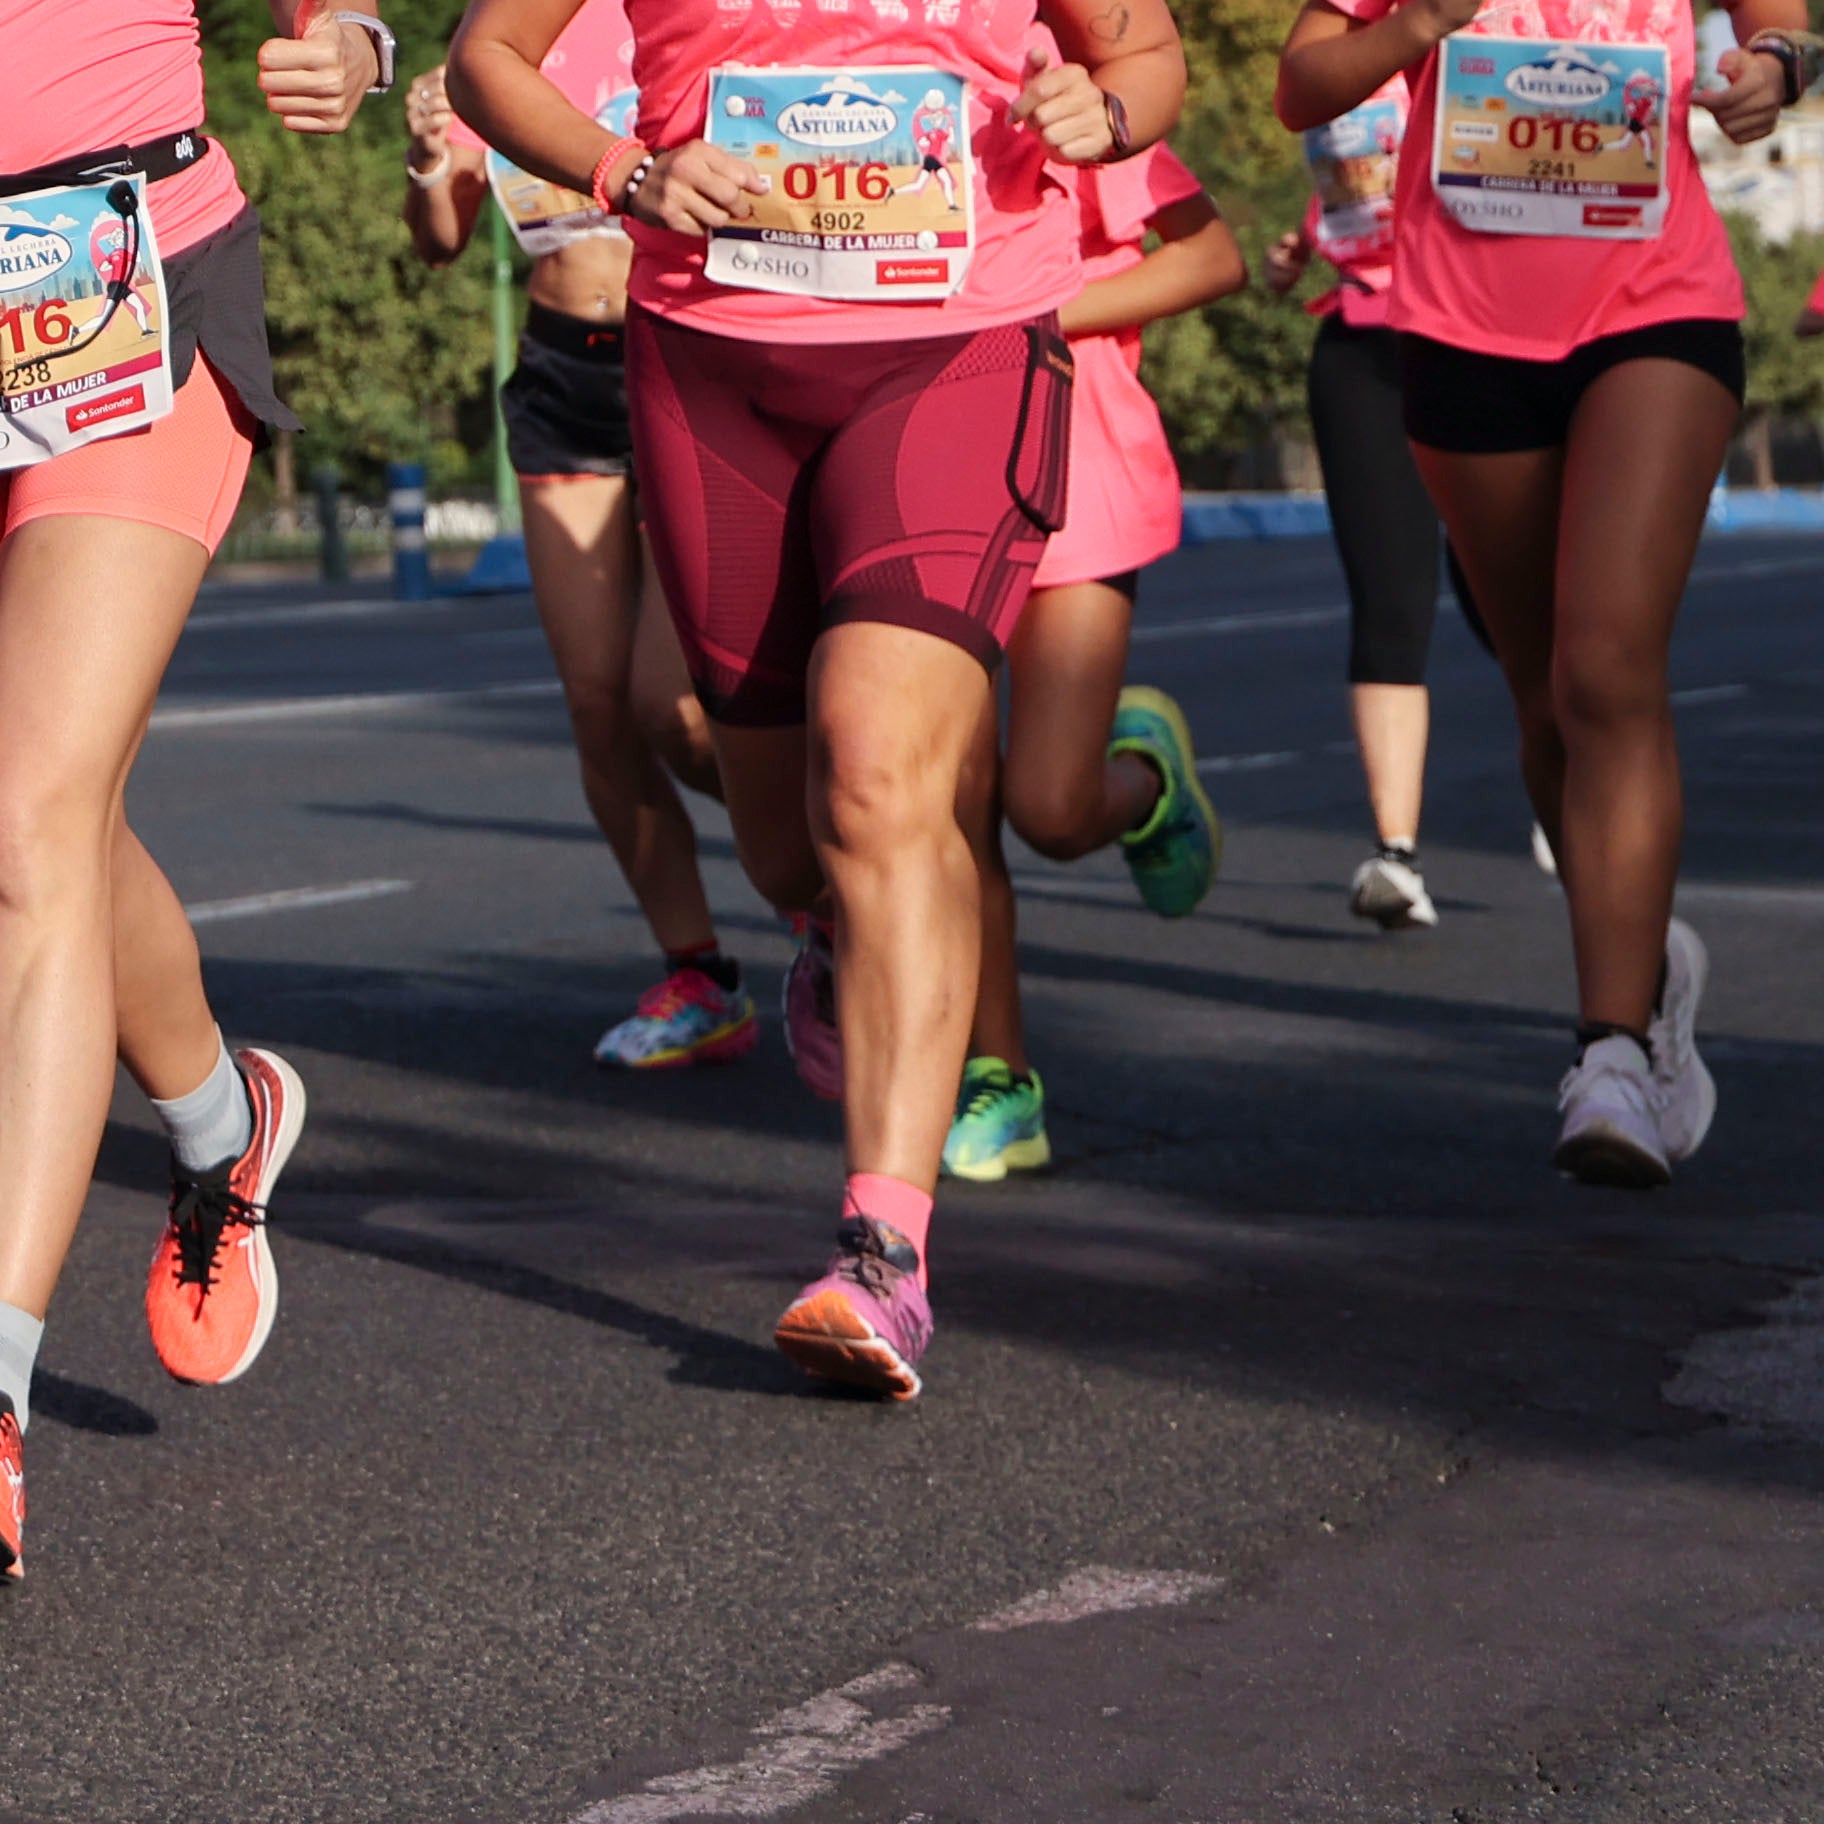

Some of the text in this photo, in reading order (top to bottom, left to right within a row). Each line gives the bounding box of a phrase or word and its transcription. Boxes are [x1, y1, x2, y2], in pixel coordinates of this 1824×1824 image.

[784, 113, 889, 135] ASTURIANA
[1509, 115, 1601, 154] 016
[1528, 159, 1576, 177] 2241
[783, 161, 890, 201] 016
[811, 212, 866, 231] 4902
[10, 238, 56, 253] LECHERA
[761, 229, 917, 250] CARRERA DE LA MUJER
[11, 394, 29, 413] DE
[33, 389, 53, 405] LA
[56, 371, 107, 398] MUJER
[88, 394, 135, 418] Santander
